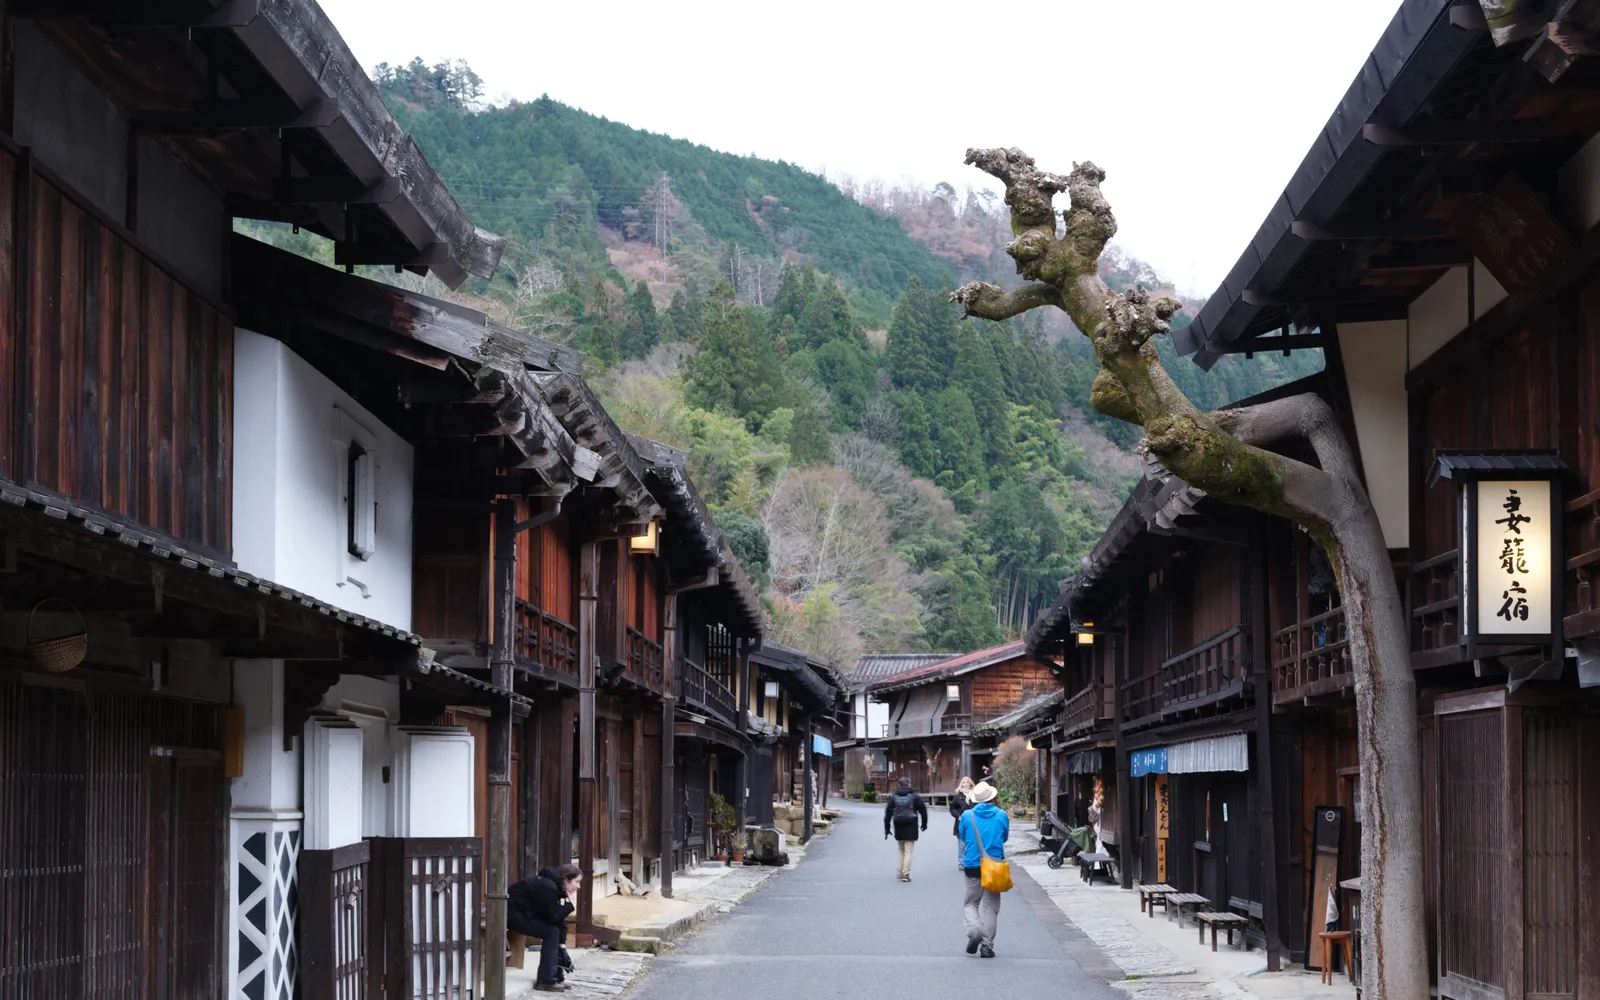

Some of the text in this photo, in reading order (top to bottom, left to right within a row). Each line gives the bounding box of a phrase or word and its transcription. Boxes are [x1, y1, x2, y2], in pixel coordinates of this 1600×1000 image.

[1495, 488, 1531, 621] 妻籠宿
[1159, 783, 1169, 831] 栗きんとん
